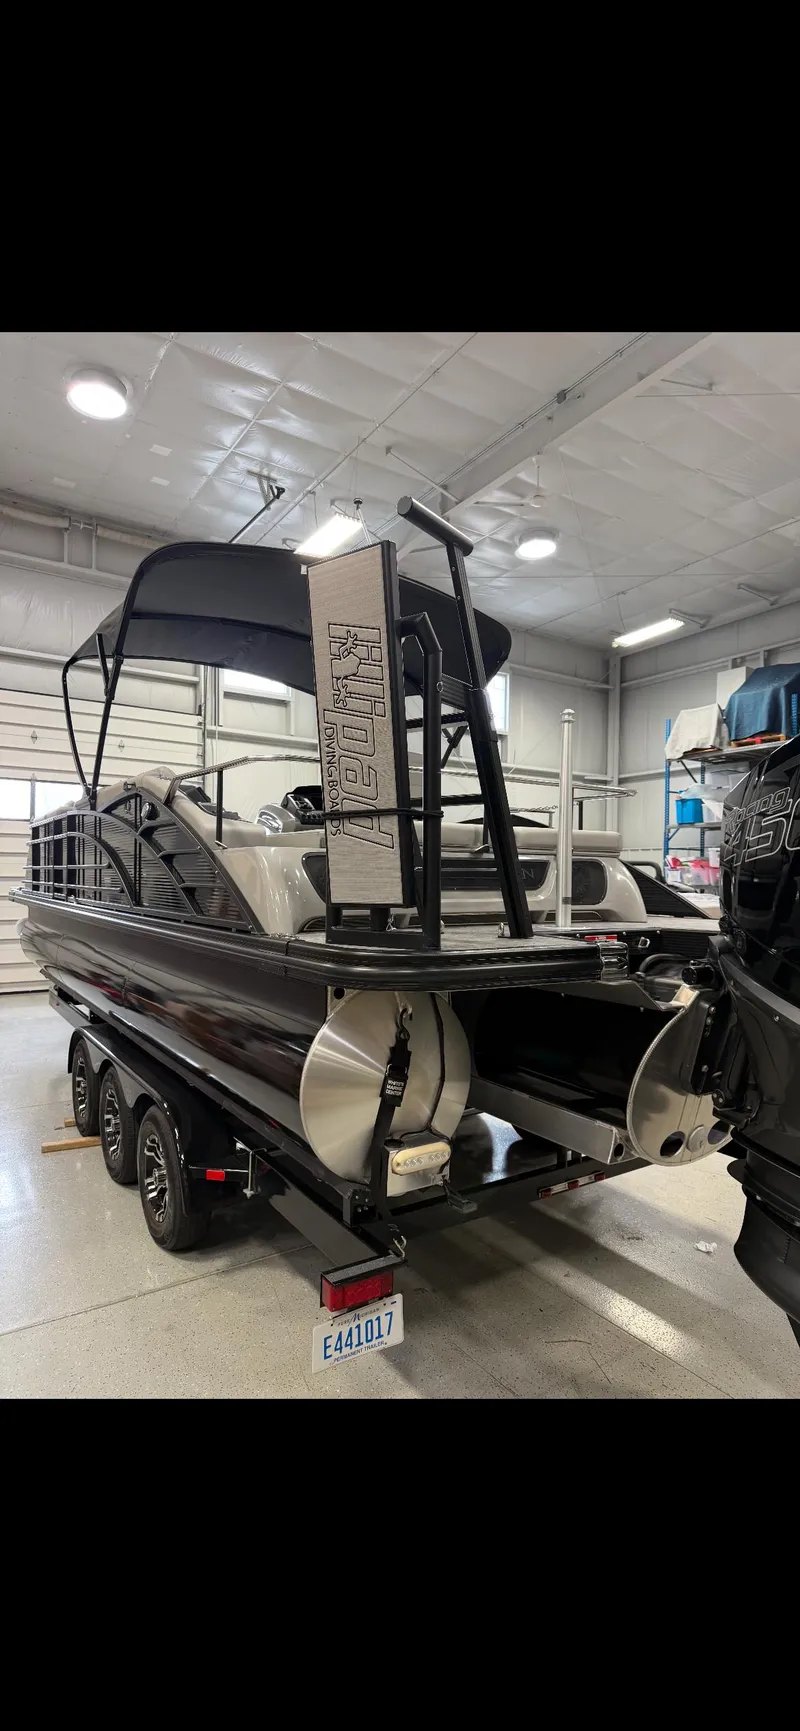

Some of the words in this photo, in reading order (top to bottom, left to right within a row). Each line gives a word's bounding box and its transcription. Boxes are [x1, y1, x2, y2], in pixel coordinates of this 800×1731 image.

[323, 727, 338, 778] DIVING
[724, 786, 790, 837] Racing
[323, 1310, 394, 1361] E441017
[333, 1348, 363, 1363] PERMANENT
[364, 1340, 385, 1353] TRAILER
